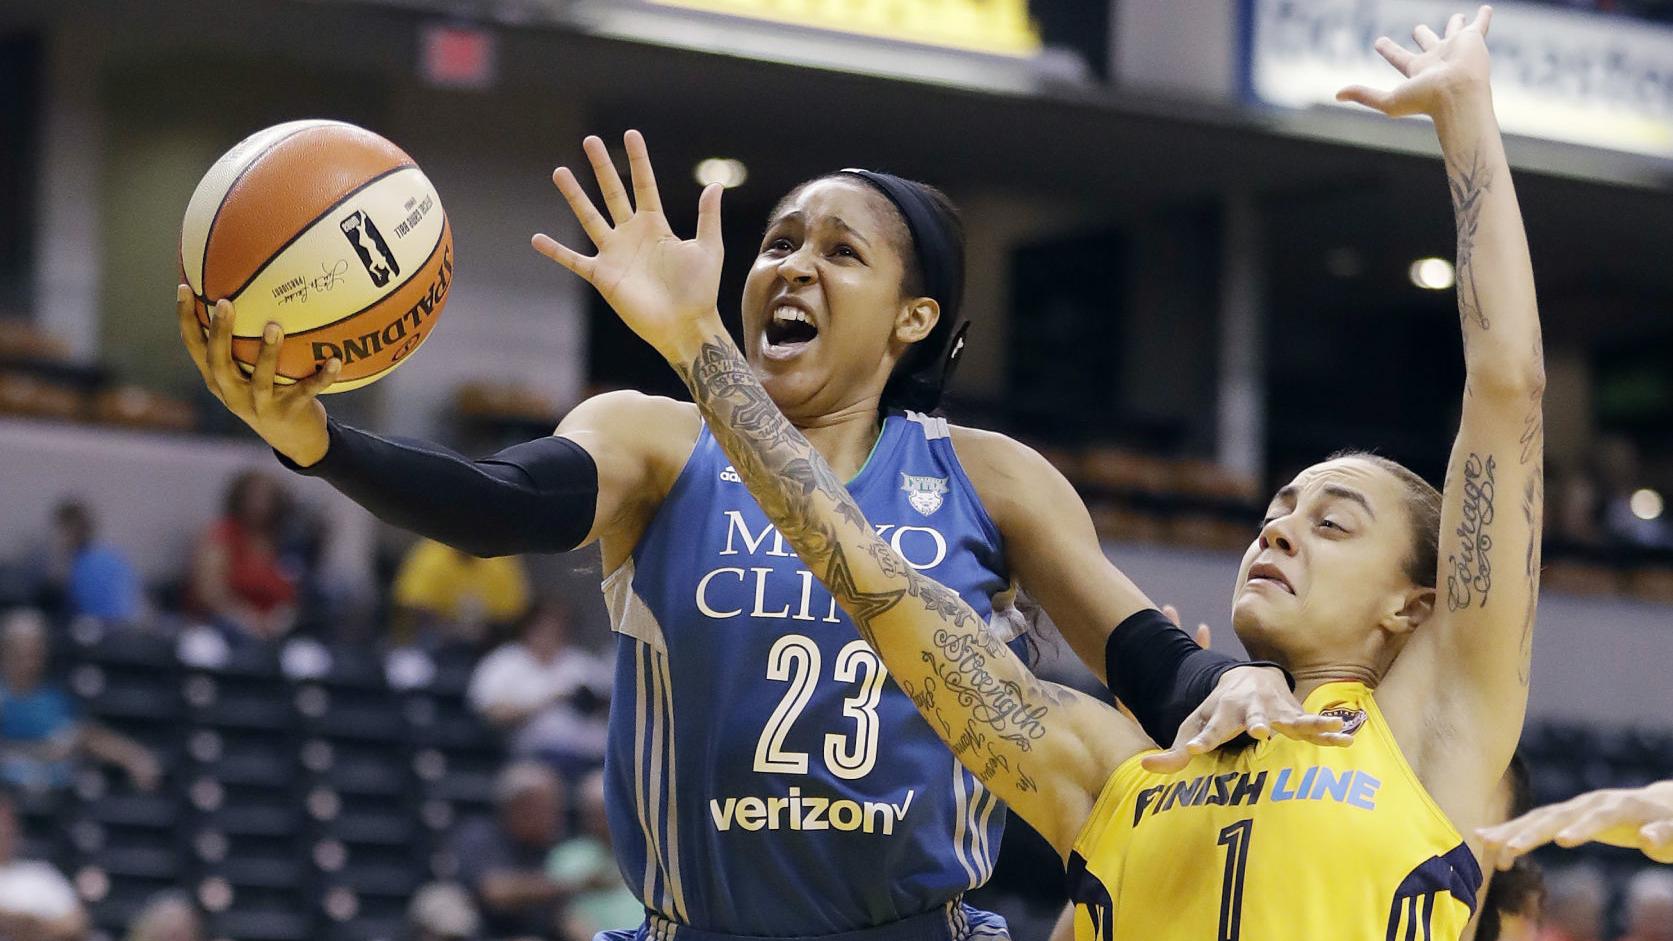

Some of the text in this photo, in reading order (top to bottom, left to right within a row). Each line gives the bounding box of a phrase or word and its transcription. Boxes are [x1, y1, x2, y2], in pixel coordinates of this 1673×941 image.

[312, 244, 453, 372] SPALDING
[719, 510, 947, 571] MO
[1448, 453, 1495, 612] Courage
[695, 567, 842, 623] CLI
[753, 634, 888, 780] 23
[933, 629, 1047, 740] Strength
[710, 787, 893, 835] verizon
[1132, 765, 1381, 828] FINISH LINE
[1217, 818, 1253, 941] 1
